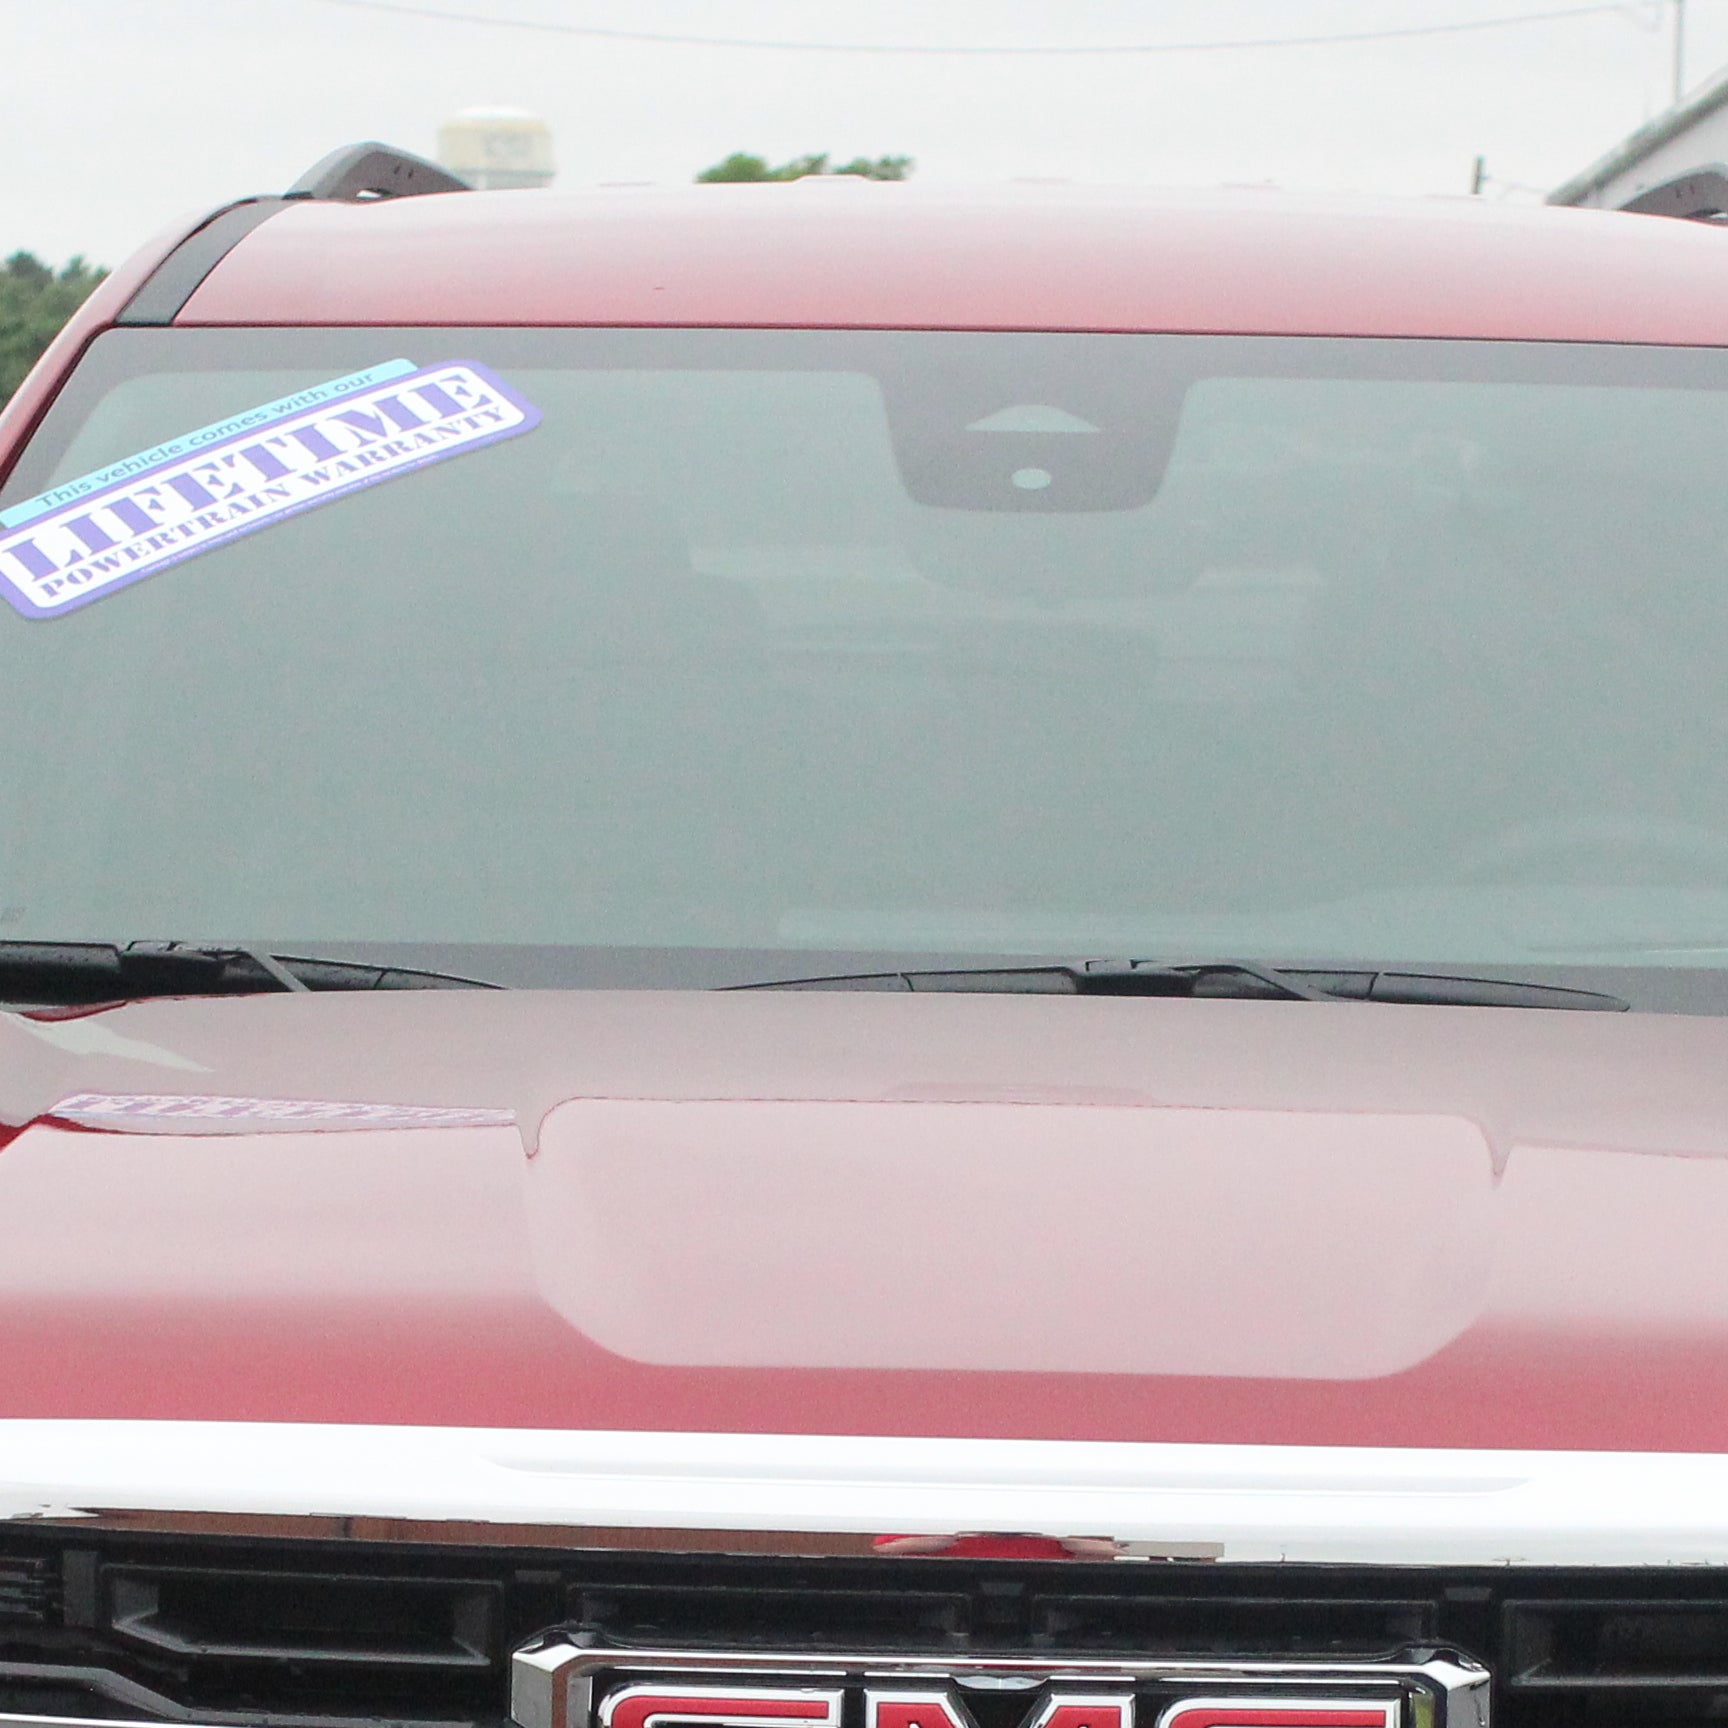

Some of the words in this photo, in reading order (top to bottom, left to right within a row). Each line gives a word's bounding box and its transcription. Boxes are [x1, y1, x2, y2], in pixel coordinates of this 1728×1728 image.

[1, 374, 494, 583] LIFETIME
[35, 483, 92, 508] This
[96, 443, 184, 483] vehicle
[189, 409, 269, 446] comes
[271, 388, 328, 415] with
[333, 372, 375, 393] our
[38, 483, 291, 598] POWERTRAIN
[298, 406, 507, 486] WARRANTY
